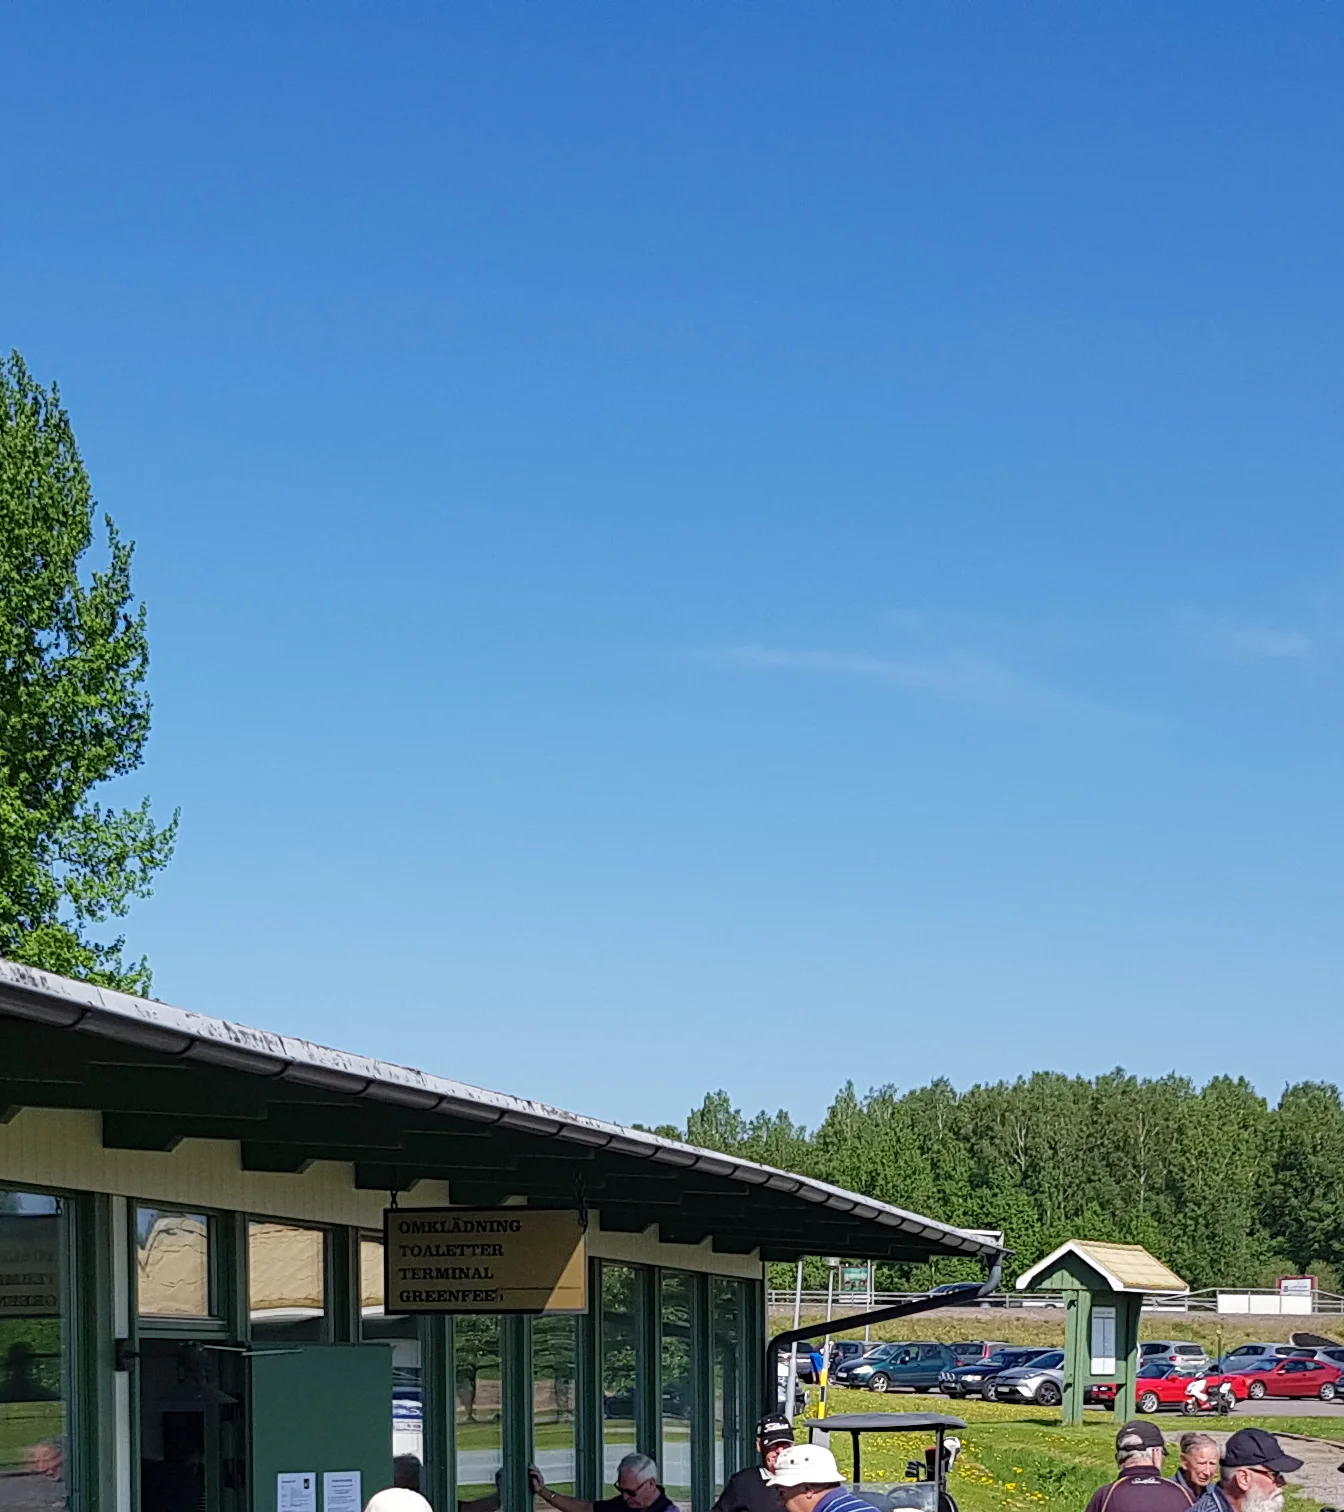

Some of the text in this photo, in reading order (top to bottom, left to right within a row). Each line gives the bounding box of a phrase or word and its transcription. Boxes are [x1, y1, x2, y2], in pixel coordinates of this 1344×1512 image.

[398, 1217, 521, 1234] OMKLÄDNING
[399, 1243, 504, 1257] TOALETTER
[399, 1267, 494, 1280] TERMINAL
[399, 1290, 503, 1303] GREENFEE
